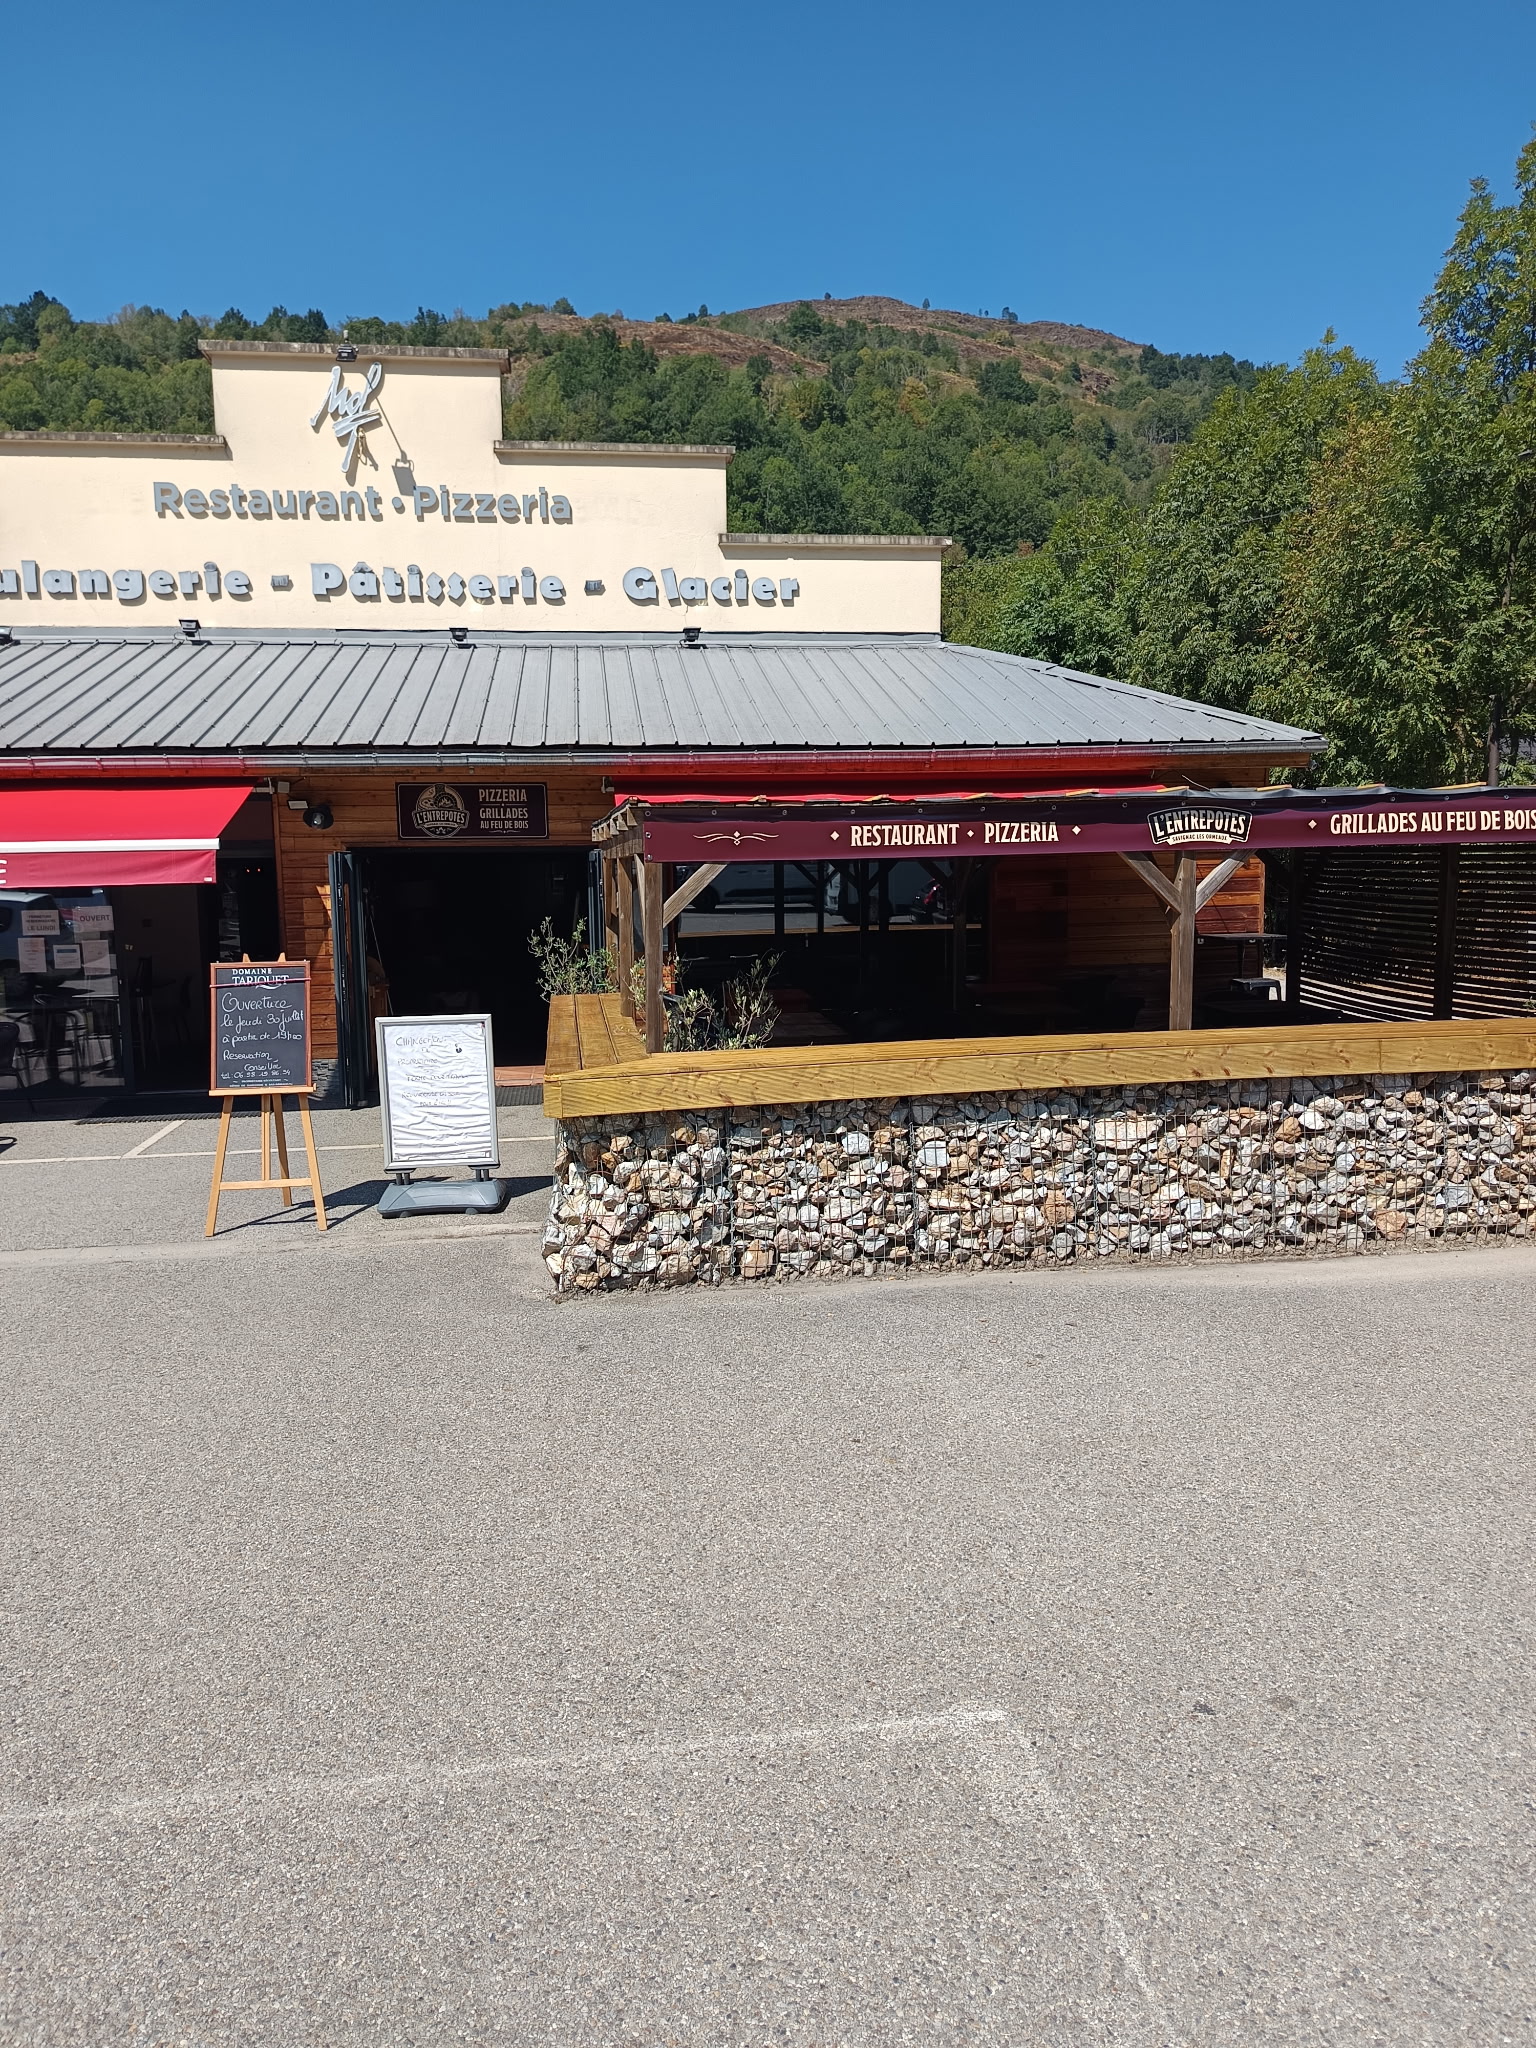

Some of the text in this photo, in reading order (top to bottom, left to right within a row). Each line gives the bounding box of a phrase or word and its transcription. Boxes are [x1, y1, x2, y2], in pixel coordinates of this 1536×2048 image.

[153, 482, 571, 520] Restaurant Pizzeria
[311, 562, 564, 600] Pâtisserie
[623, 567, 798, 601] Glacier
[478, 788, 528, 802] PIZZERIA
[479, 807, 529, 819] GRILLADES
[480, 820, 529, 829] AU FEU DE BOIS
[1330, 812, 1418, 834] GRILLADES
[1420, 811, 1444, 832] AU
[1446, 811, 1477, 831] FEU
[1480, 810, 1501, 830] DE
[850, 822, 1060, 847] RESTAURANT PIZZERIA
[79, 914, 110, 922] OUVERT
[221, 992, 293, 1013] Ouverture
[220, 1013, 234, 1027] le
[266, 1013, 280, 1024] 30
[259, 1032, 271, 1040] de
